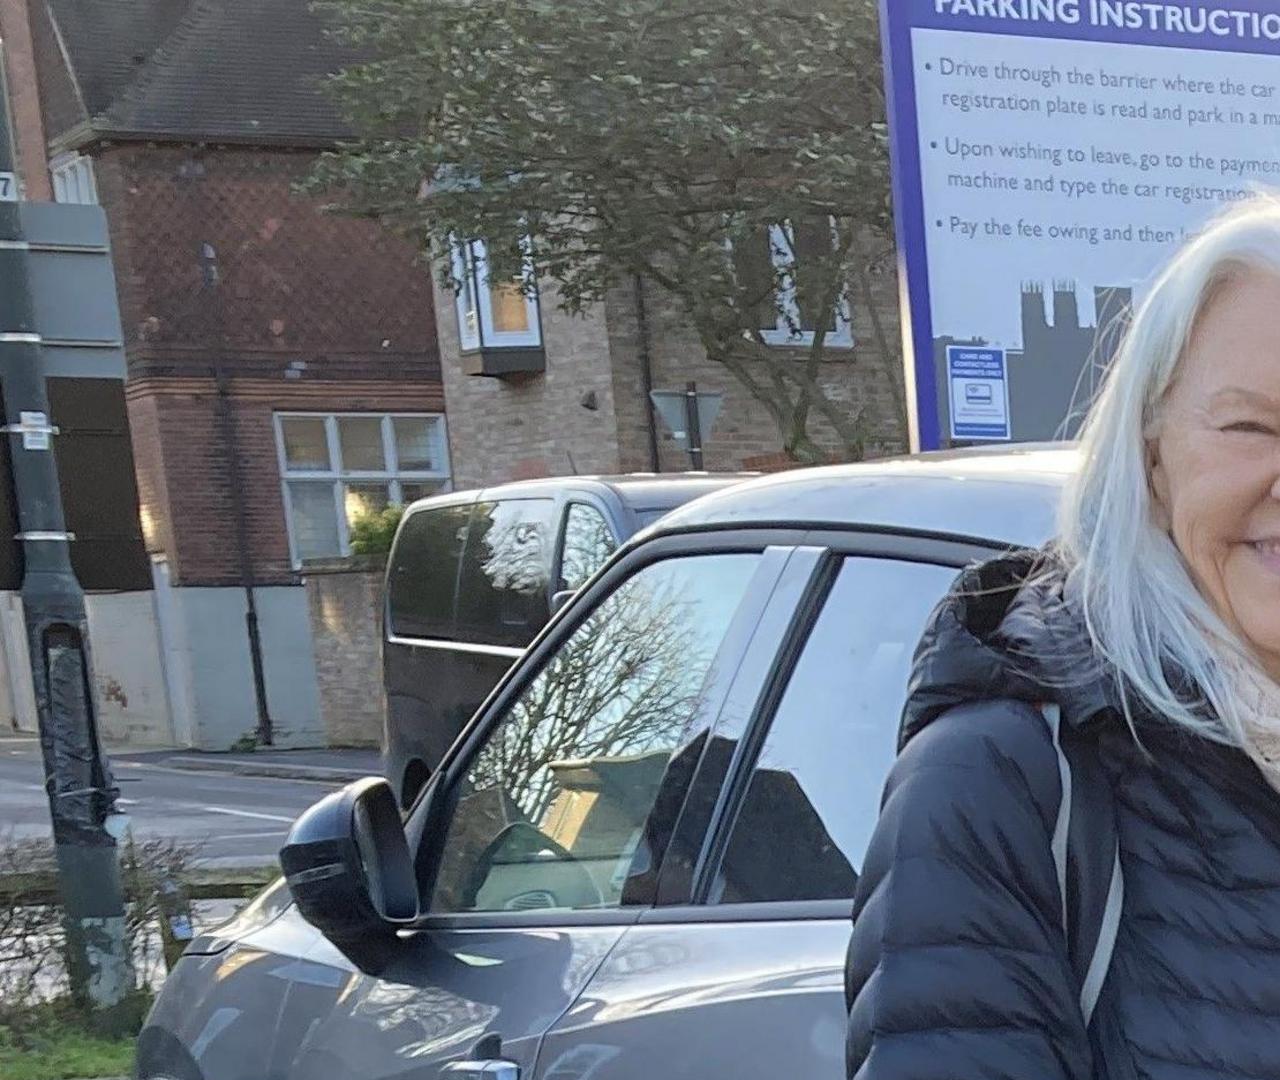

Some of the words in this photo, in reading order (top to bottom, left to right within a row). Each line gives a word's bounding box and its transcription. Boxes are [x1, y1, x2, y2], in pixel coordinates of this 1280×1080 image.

[940, 57, 988, 79] Drive
[994, 61, 1061, 88] through
[1067, 66, 1095, 86] the
[1100, 69, 1157, 90] barrier
[1163, 74, 1215, 95] where
[1220, 77, 1246, 96] the
[1251, 83, 1276, 98] car
[942, 91, 1040, 113] registration
[1047, 96, 1088, 118] plate
[1093, 101, 1105, 117] is
[1112, 101, 1147, 119] read
[1153, 103, 1182, 121] and
[1187, 105, 1223, 126] park
[1230, 107, 1244, 124] in
[1250, 112, 1258, 125] a
[945, 136, 993, 159] Upon
[999, 142, 1062, 167] wishing
[1067, 148, 1085, 164] to
[1140, 153, 1160, 171] go
[1165, 154, 1183, 169] to
[1189, 151, 1215, 170] the
[948, 172, 1018, 190] machine
[1024, 176, 1054, 192] and
[1060, 179, 1096, 199] type
[1101, 178, 1128, 196] the
[1134, 184, 1158, 198] car
[950, 216, 978, 239] Pay
[984, 218, 1011, 236] the
[1017, 218, 1042, 238] fee
[1048, 227, 1099, 245] owing
[1103, 224, 1132, 242] and
[1138, 225, 1174, 243] then
